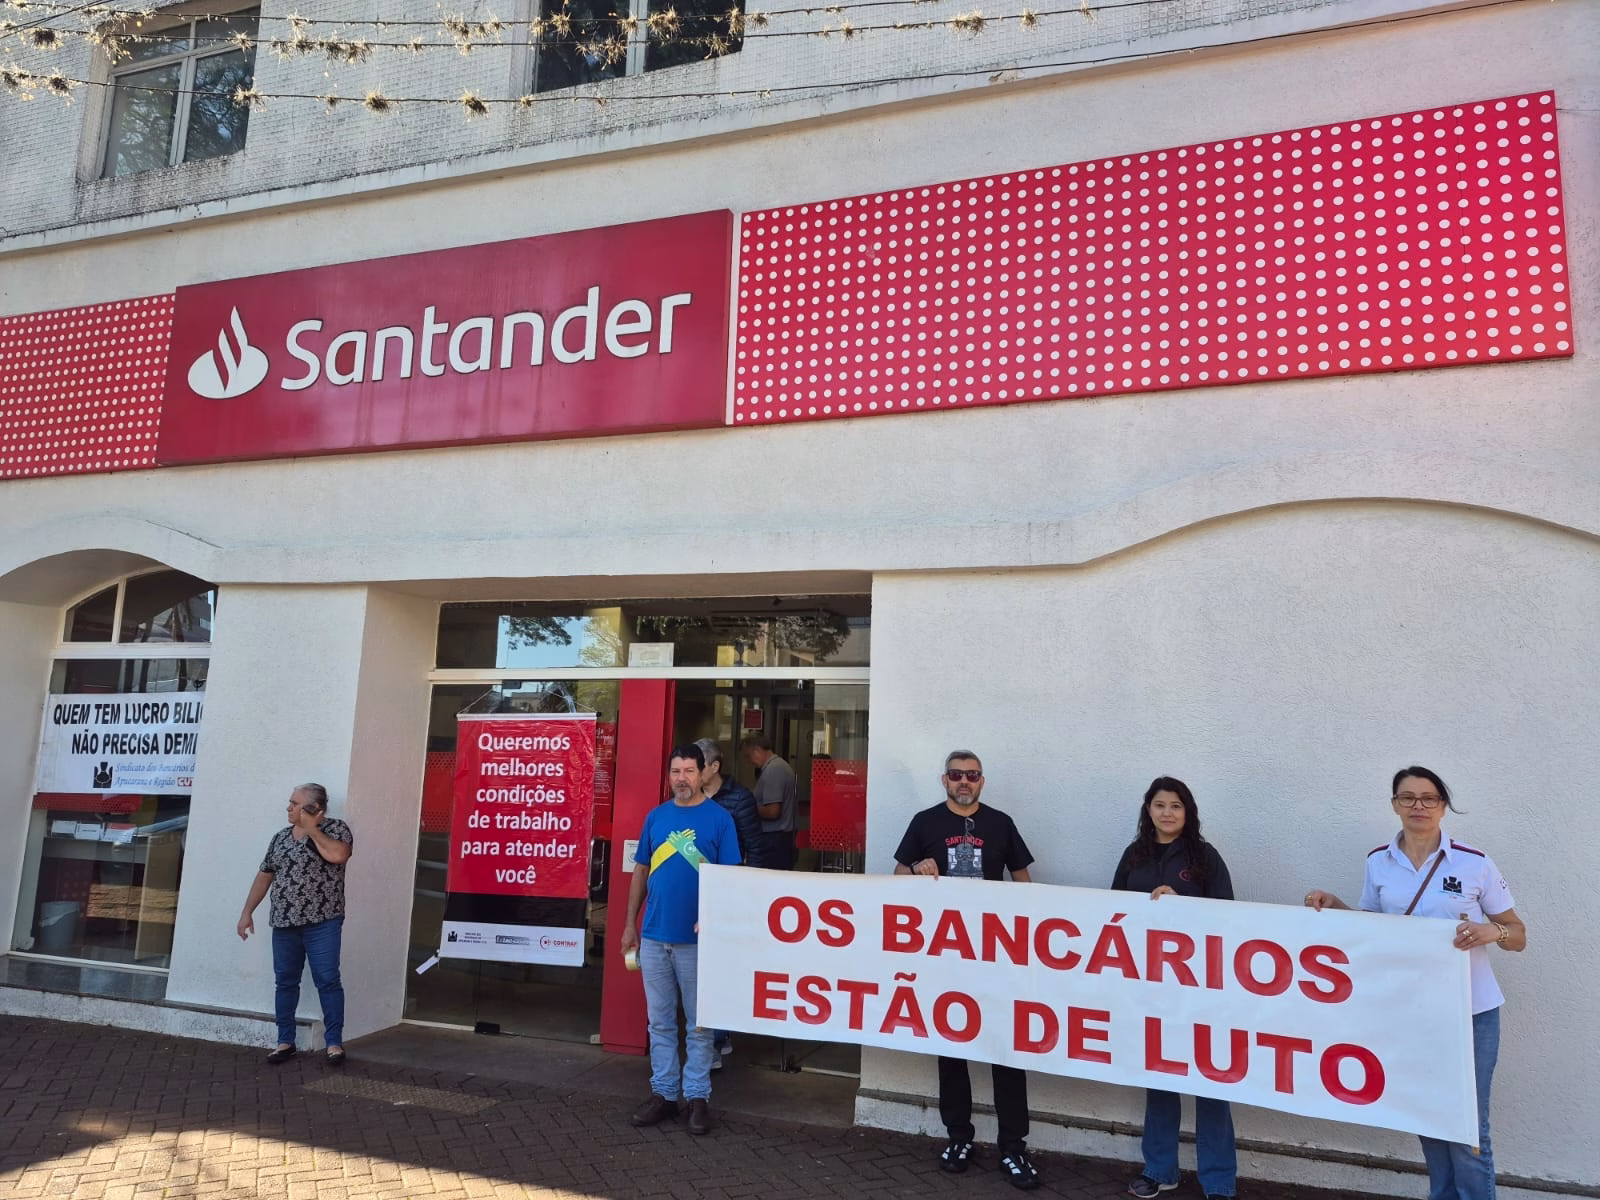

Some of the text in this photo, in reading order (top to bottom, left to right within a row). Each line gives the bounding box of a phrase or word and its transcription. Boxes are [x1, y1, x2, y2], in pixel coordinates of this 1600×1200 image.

[280, 286, 692, 391] Santander
[54, 704, 91, 727] QUEM
[94, 703, 121, 725] TEM
[124, 702, 170, 725] LUCRO
[72, 729, 198, 755] NÃO PRECISA DEMI
[478, 733, 571, 752] Queremos
[480, 758, 564, 777] melhores
[476, 784, 566, 807] condições
[468, 810, 572, 831] de trabalho
[461, 838, 577, 859] para atender
[495, 865, 537, 885] você
[767, 895, 1353, 1003] OS BANCÁRIOS
[753, 971, 1386, 1105] ESTÃO DE LUTO
